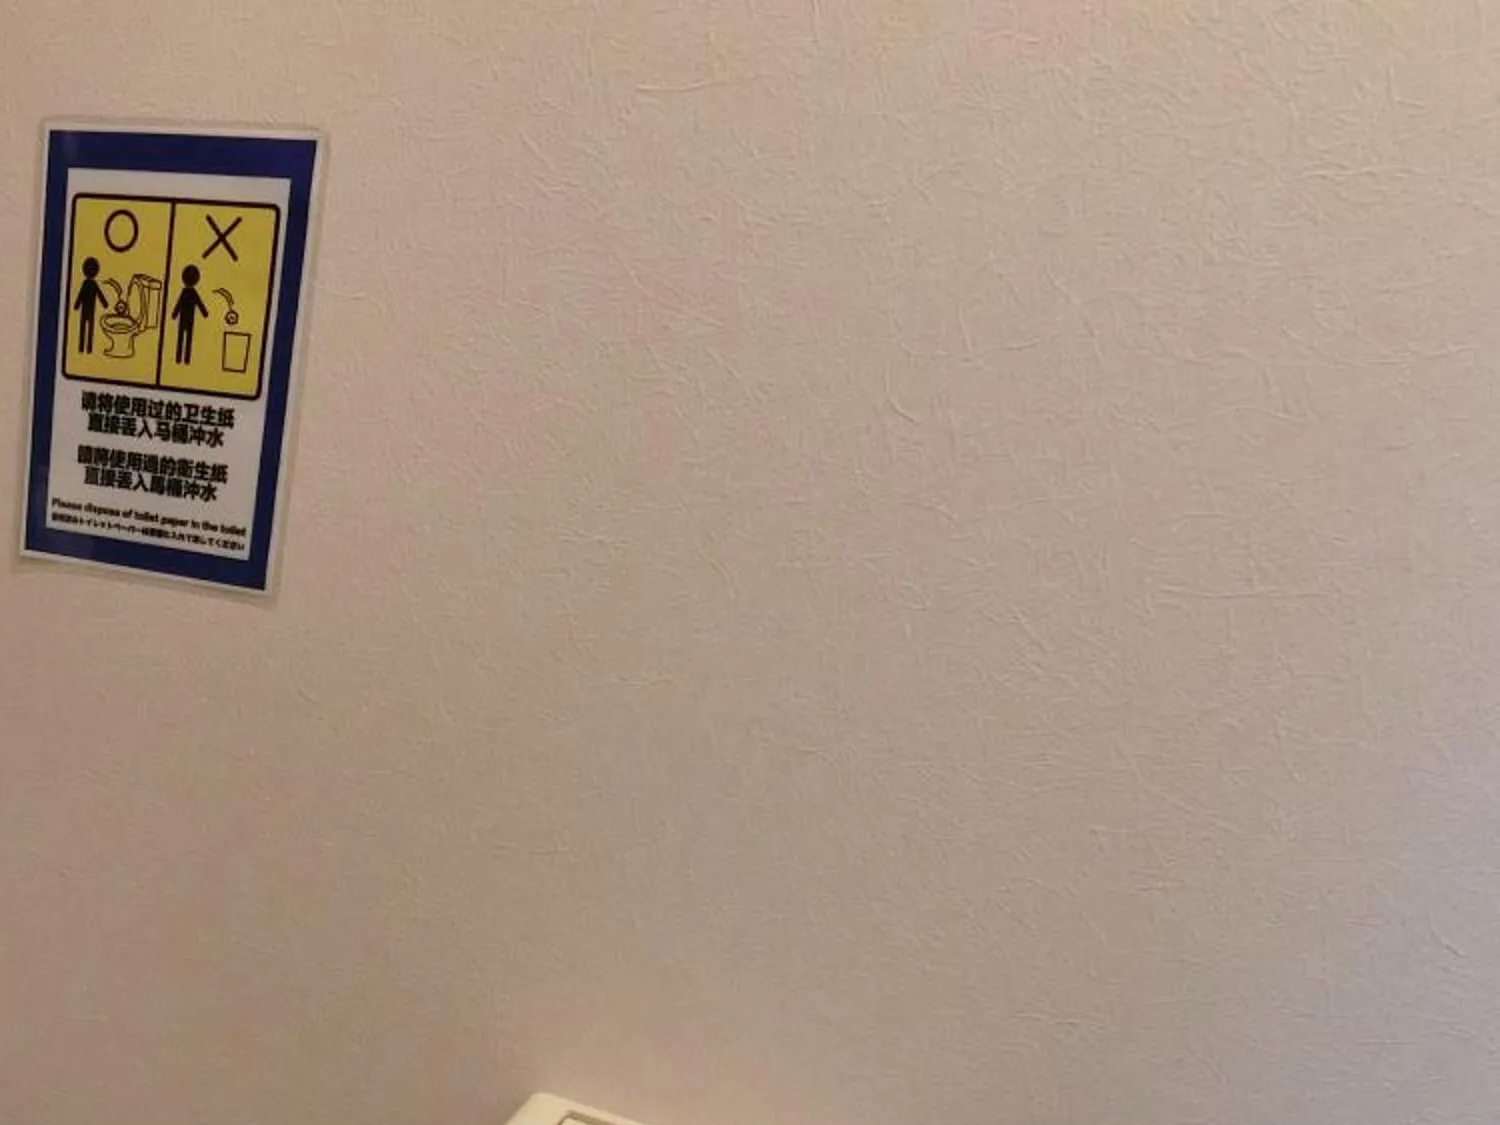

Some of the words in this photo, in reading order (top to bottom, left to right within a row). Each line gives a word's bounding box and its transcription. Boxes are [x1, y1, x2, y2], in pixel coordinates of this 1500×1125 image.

[51, 497, 82, 511] Please
[84, 502, 120, 517] dispose
[122, 508, 133, 518] of
[134, 511, 159, 523] toilet
[160, 516, 189, 528] paper
[202, 520, 218, 533] the
[220, 523, 247, 537] toilet
